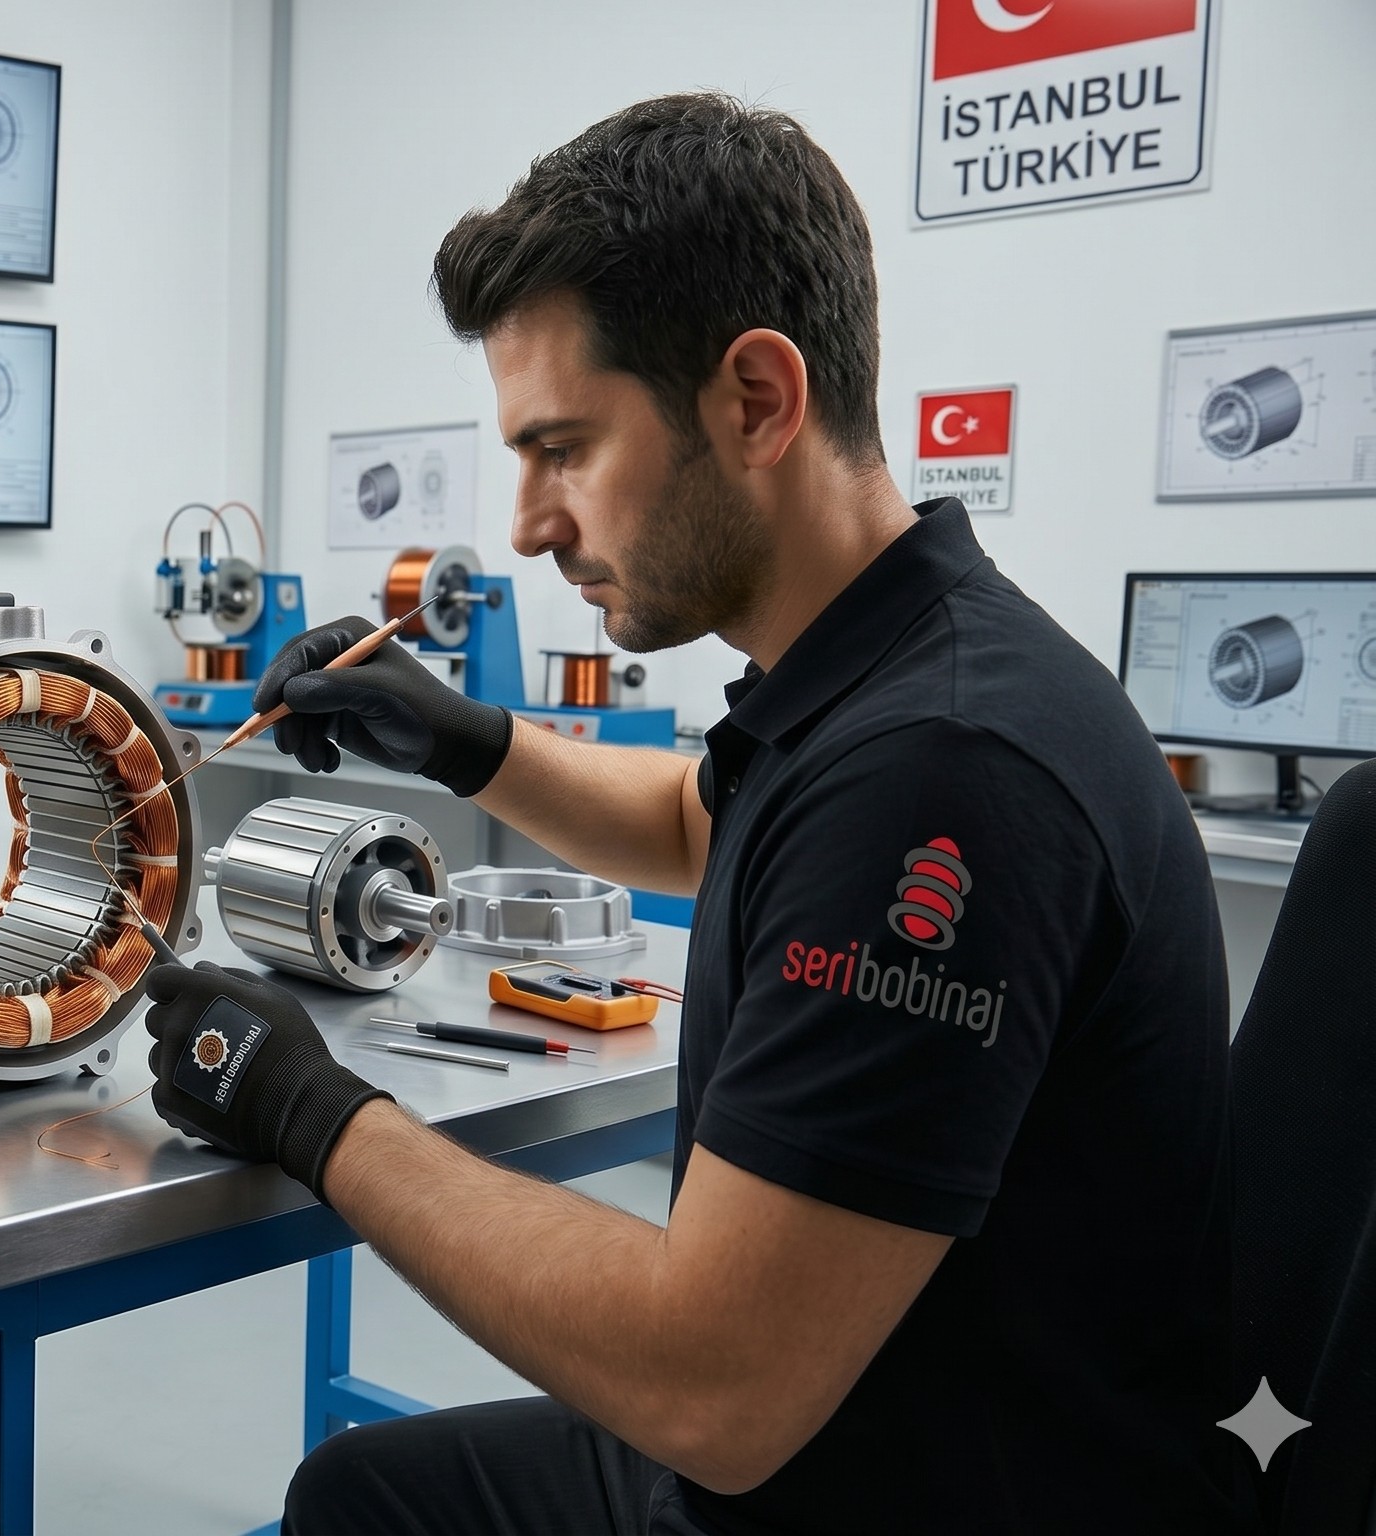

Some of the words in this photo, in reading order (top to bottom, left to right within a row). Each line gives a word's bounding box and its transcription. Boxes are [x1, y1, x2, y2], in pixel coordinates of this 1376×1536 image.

[941, 65, 1180, 141] İSTANBUL
[954, 129, 1162, 196] TÜRKİYE
[782, 941, 1007, 1048] seribobinaj
